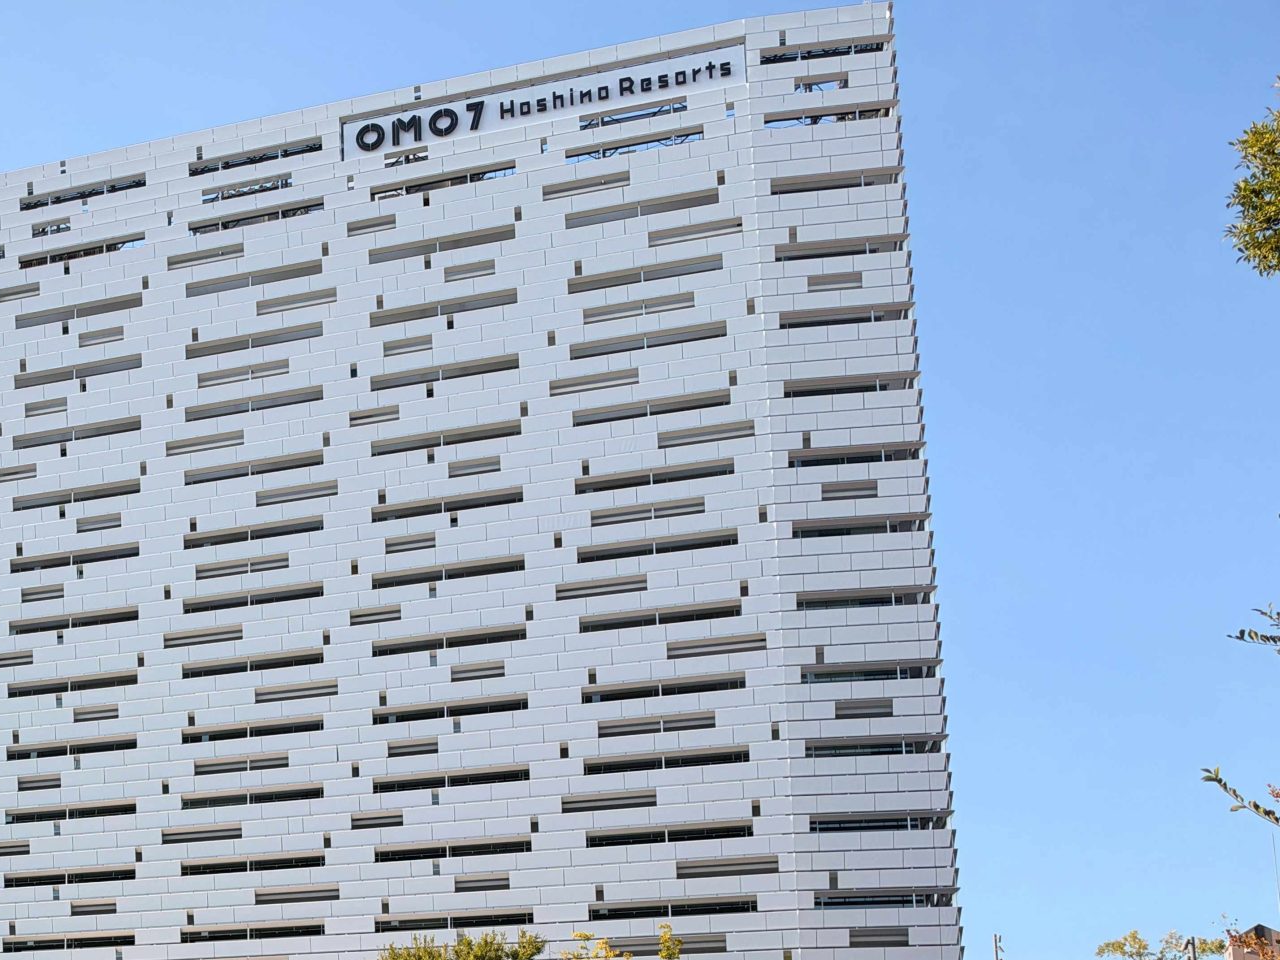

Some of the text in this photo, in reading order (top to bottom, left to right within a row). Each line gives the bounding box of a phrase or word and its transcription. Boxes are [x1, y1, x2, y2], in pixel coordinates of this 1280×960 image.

[356, 60, 732, 152] OMO7 Hoshino Resorts
